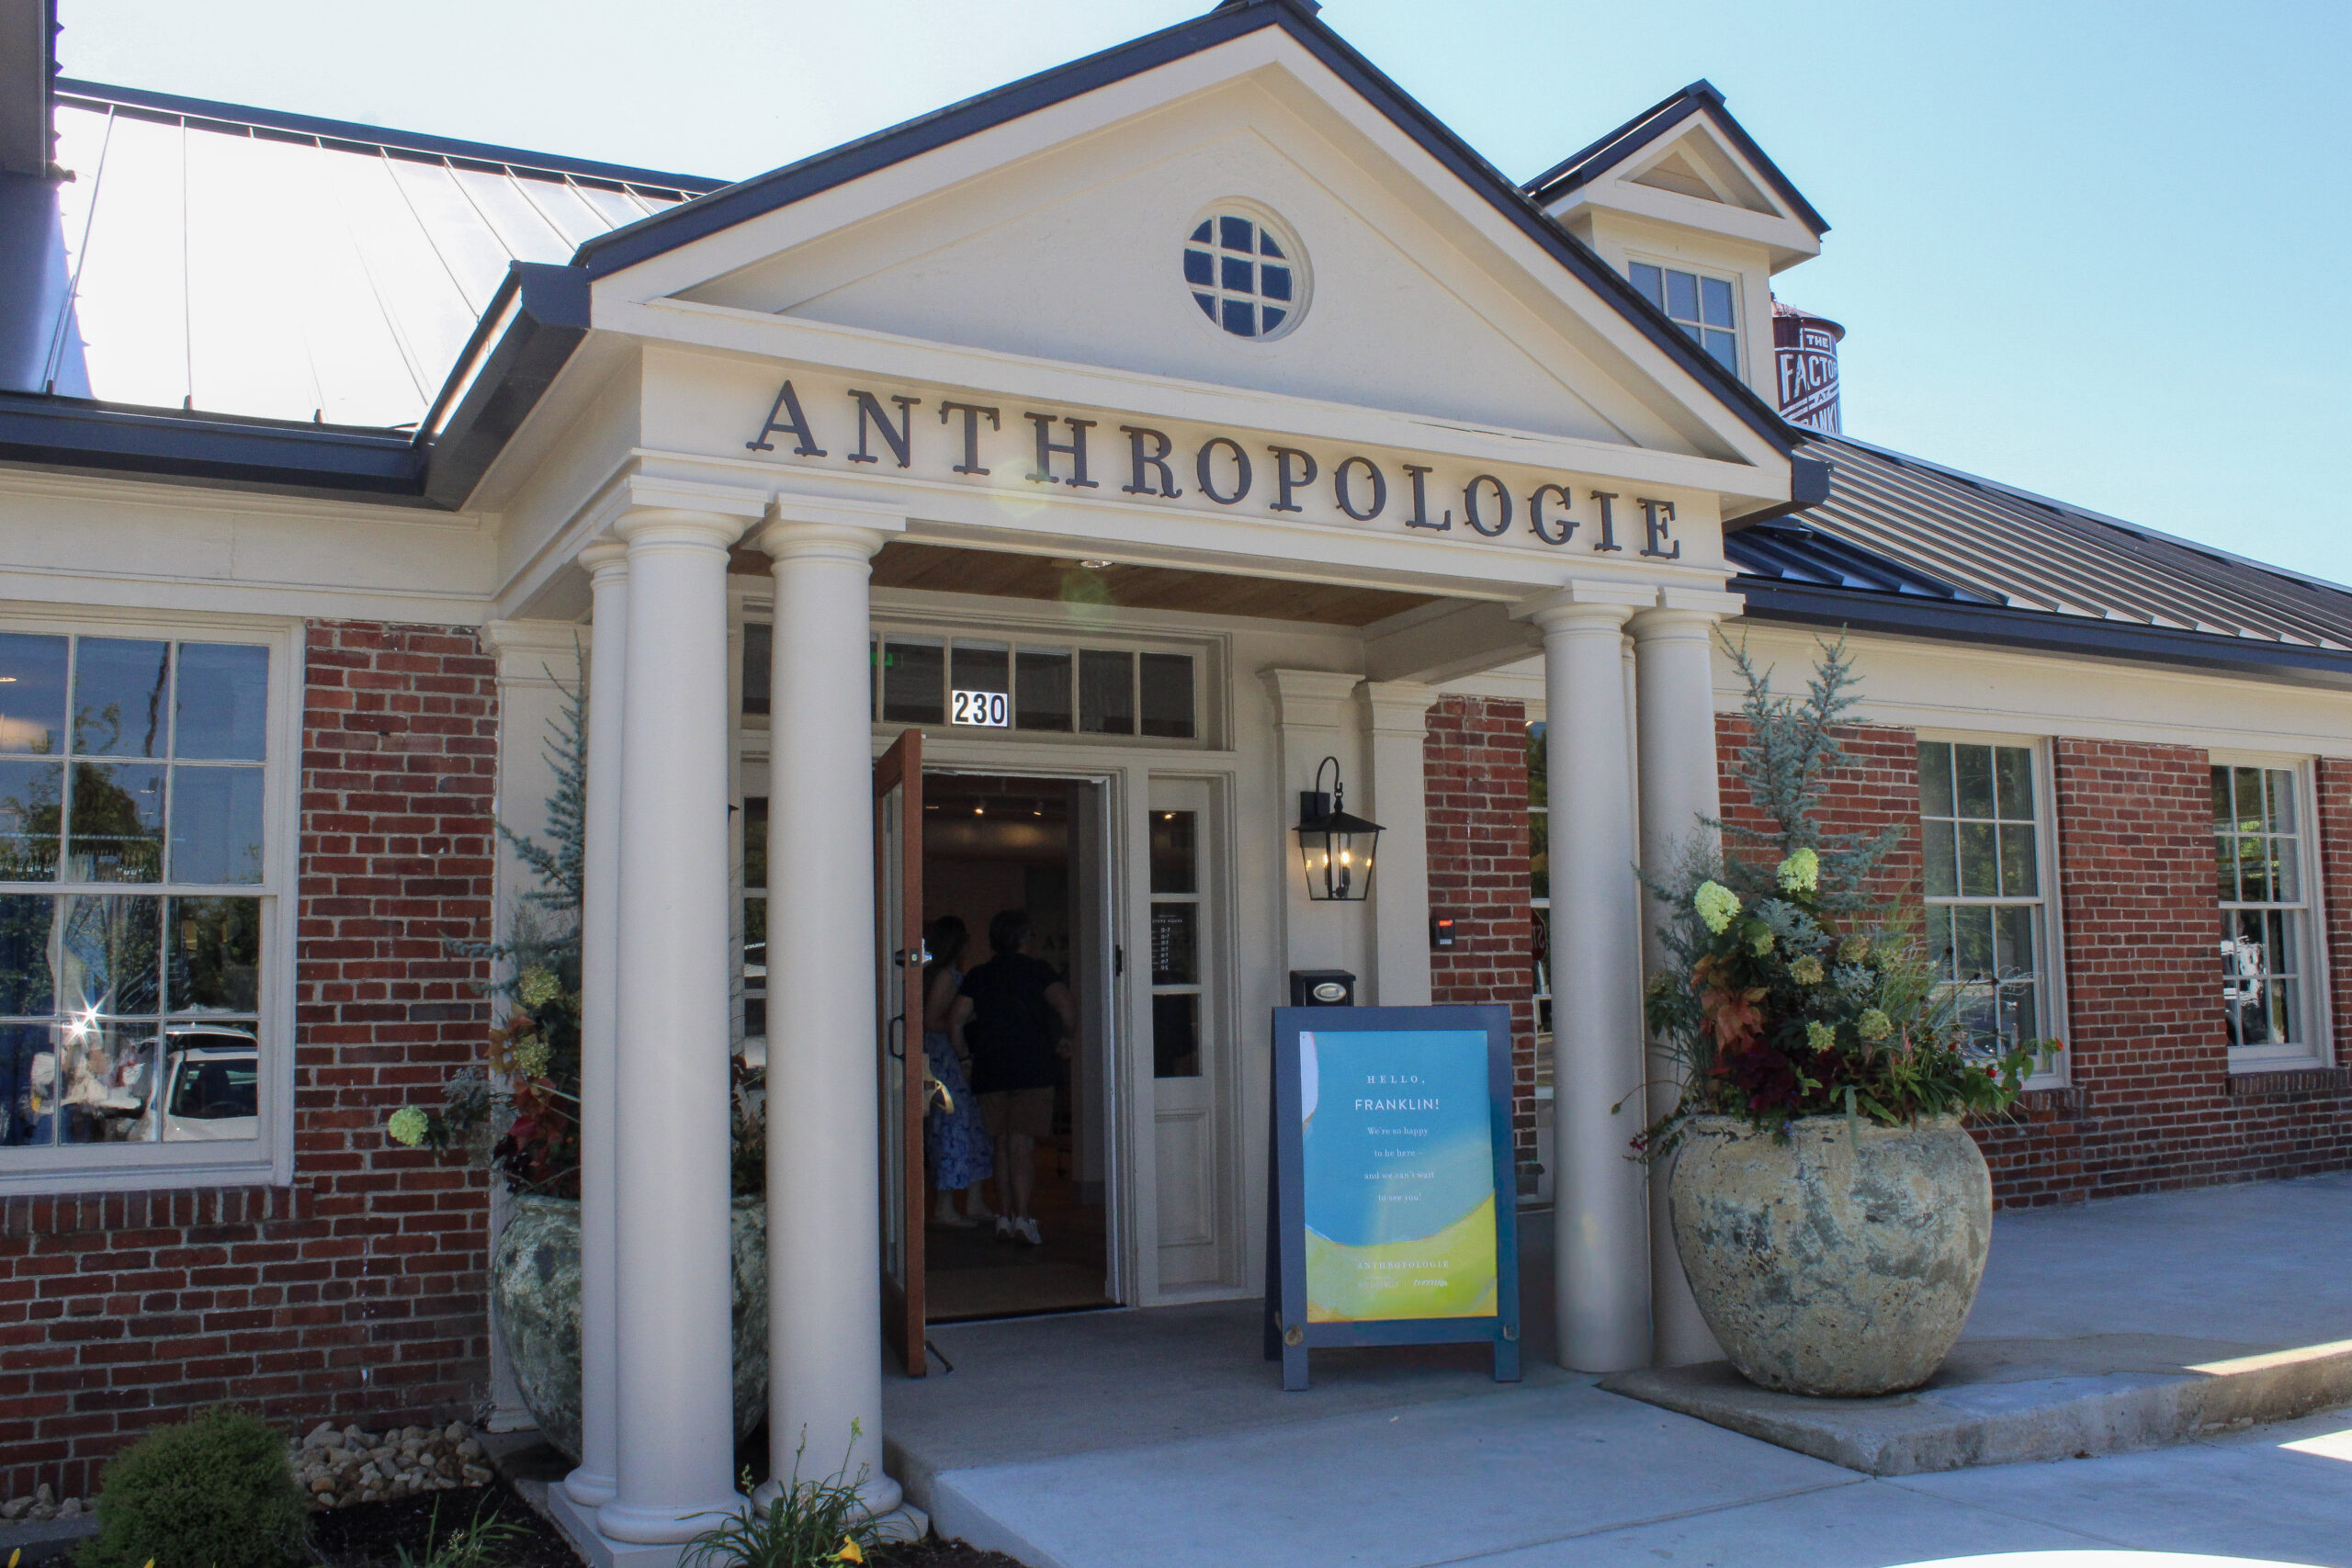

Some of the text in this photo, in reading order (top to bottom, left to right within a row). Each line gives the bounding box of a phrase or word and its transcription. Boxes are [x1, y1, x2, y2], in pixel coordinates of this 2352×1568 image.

[1806, 334, 1828, 348] THE
[1818, 389, 1828, 402] AT
[745, 379, 1681, 560] ANTHROPOLOGIE
[955, 692, 1005, 724] 230
[1355, 1099, 1440, 1111] FRANKLIN!
[1367, 1126, 1390, 1135] We're
[1404, 1126, 1429, 1137] happy
[1374, 1149, 1383, 1157] to
[1385, 1148, 1395, 1157] be
[1396, 1148, 1416, 1157] here
[1417, 1171, 1434, 1179] wait
[1404, 1191, 1421, 1203] you!
[1357, 1260, 1448, 1269] ANTHROPOLOGIE
